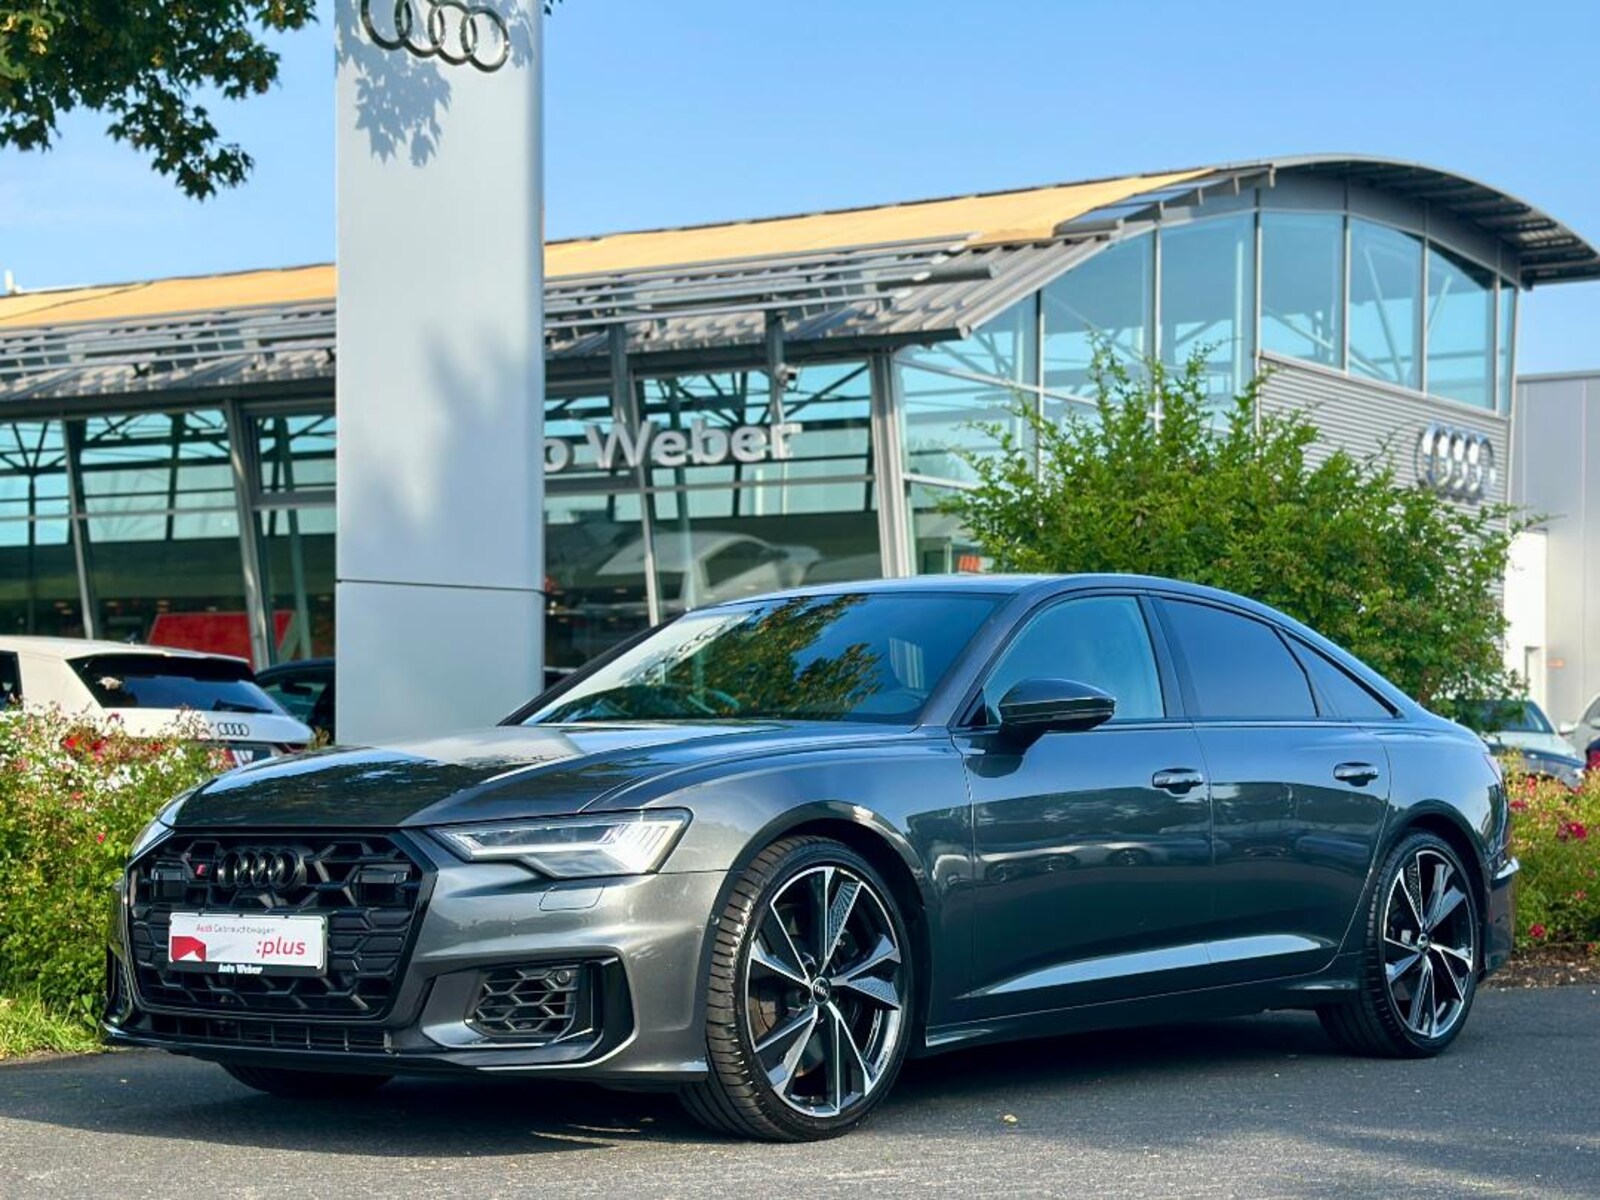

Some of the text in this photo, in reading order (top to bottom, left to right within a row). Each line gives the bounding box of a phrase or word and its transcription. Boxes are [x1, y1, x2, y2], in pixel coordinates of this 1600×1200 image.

[586, 418, 803, 469] Weber
[256, 936, 307, 959] :plus
[236, 963, 263, 975] Weber
